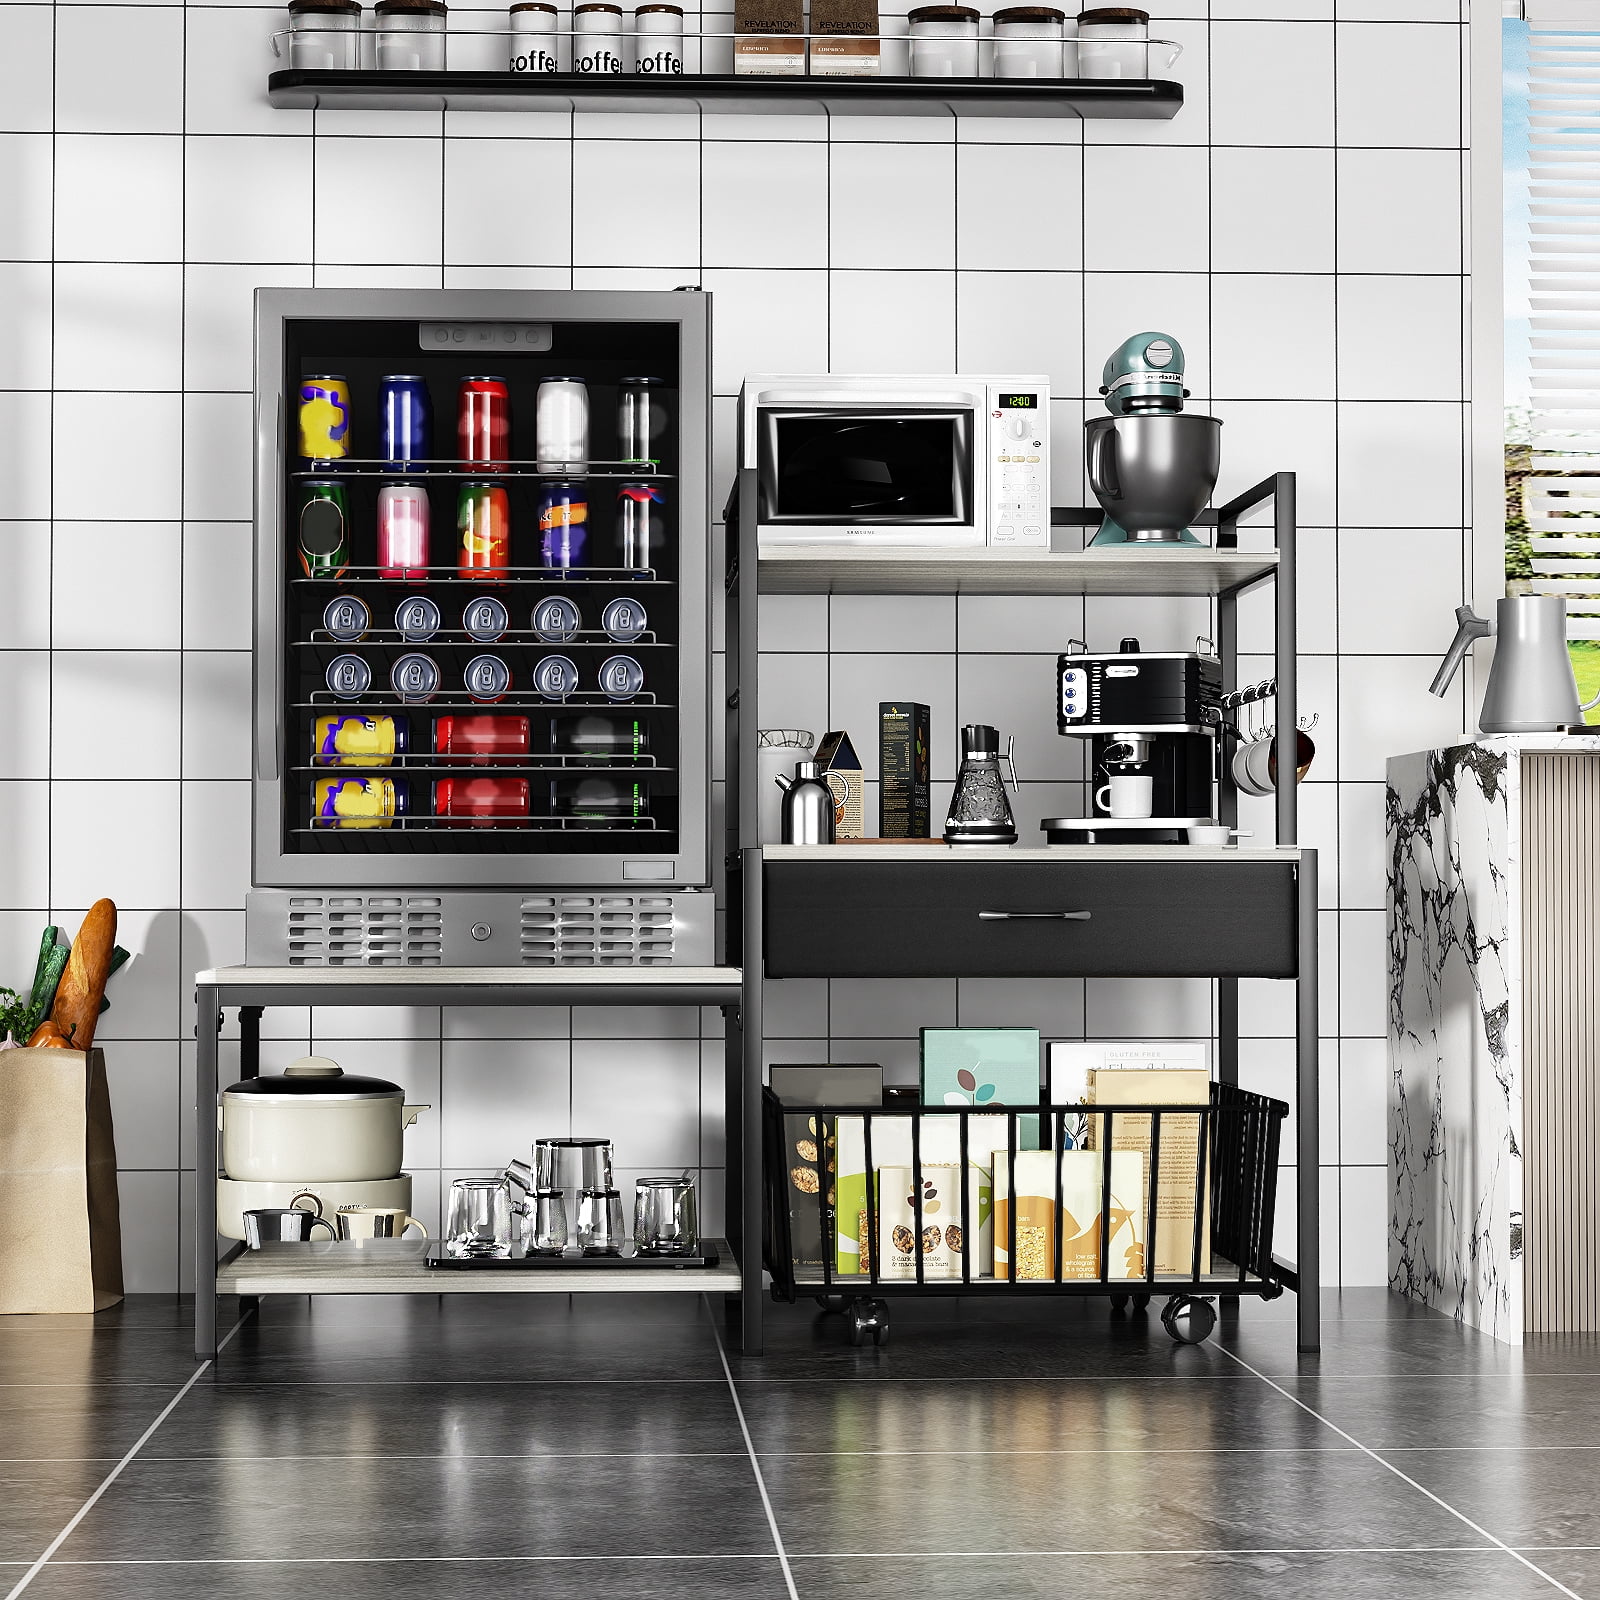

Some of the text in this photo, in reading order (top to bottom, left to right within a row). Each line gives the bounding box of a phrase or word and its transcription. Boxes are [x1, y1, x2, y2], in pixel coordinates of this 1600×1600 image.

[744, 20, 797, 28] REVELATION
[819, 21, 872, 29] REVELATION
[1010, 396, 1030, 406] 12:00
